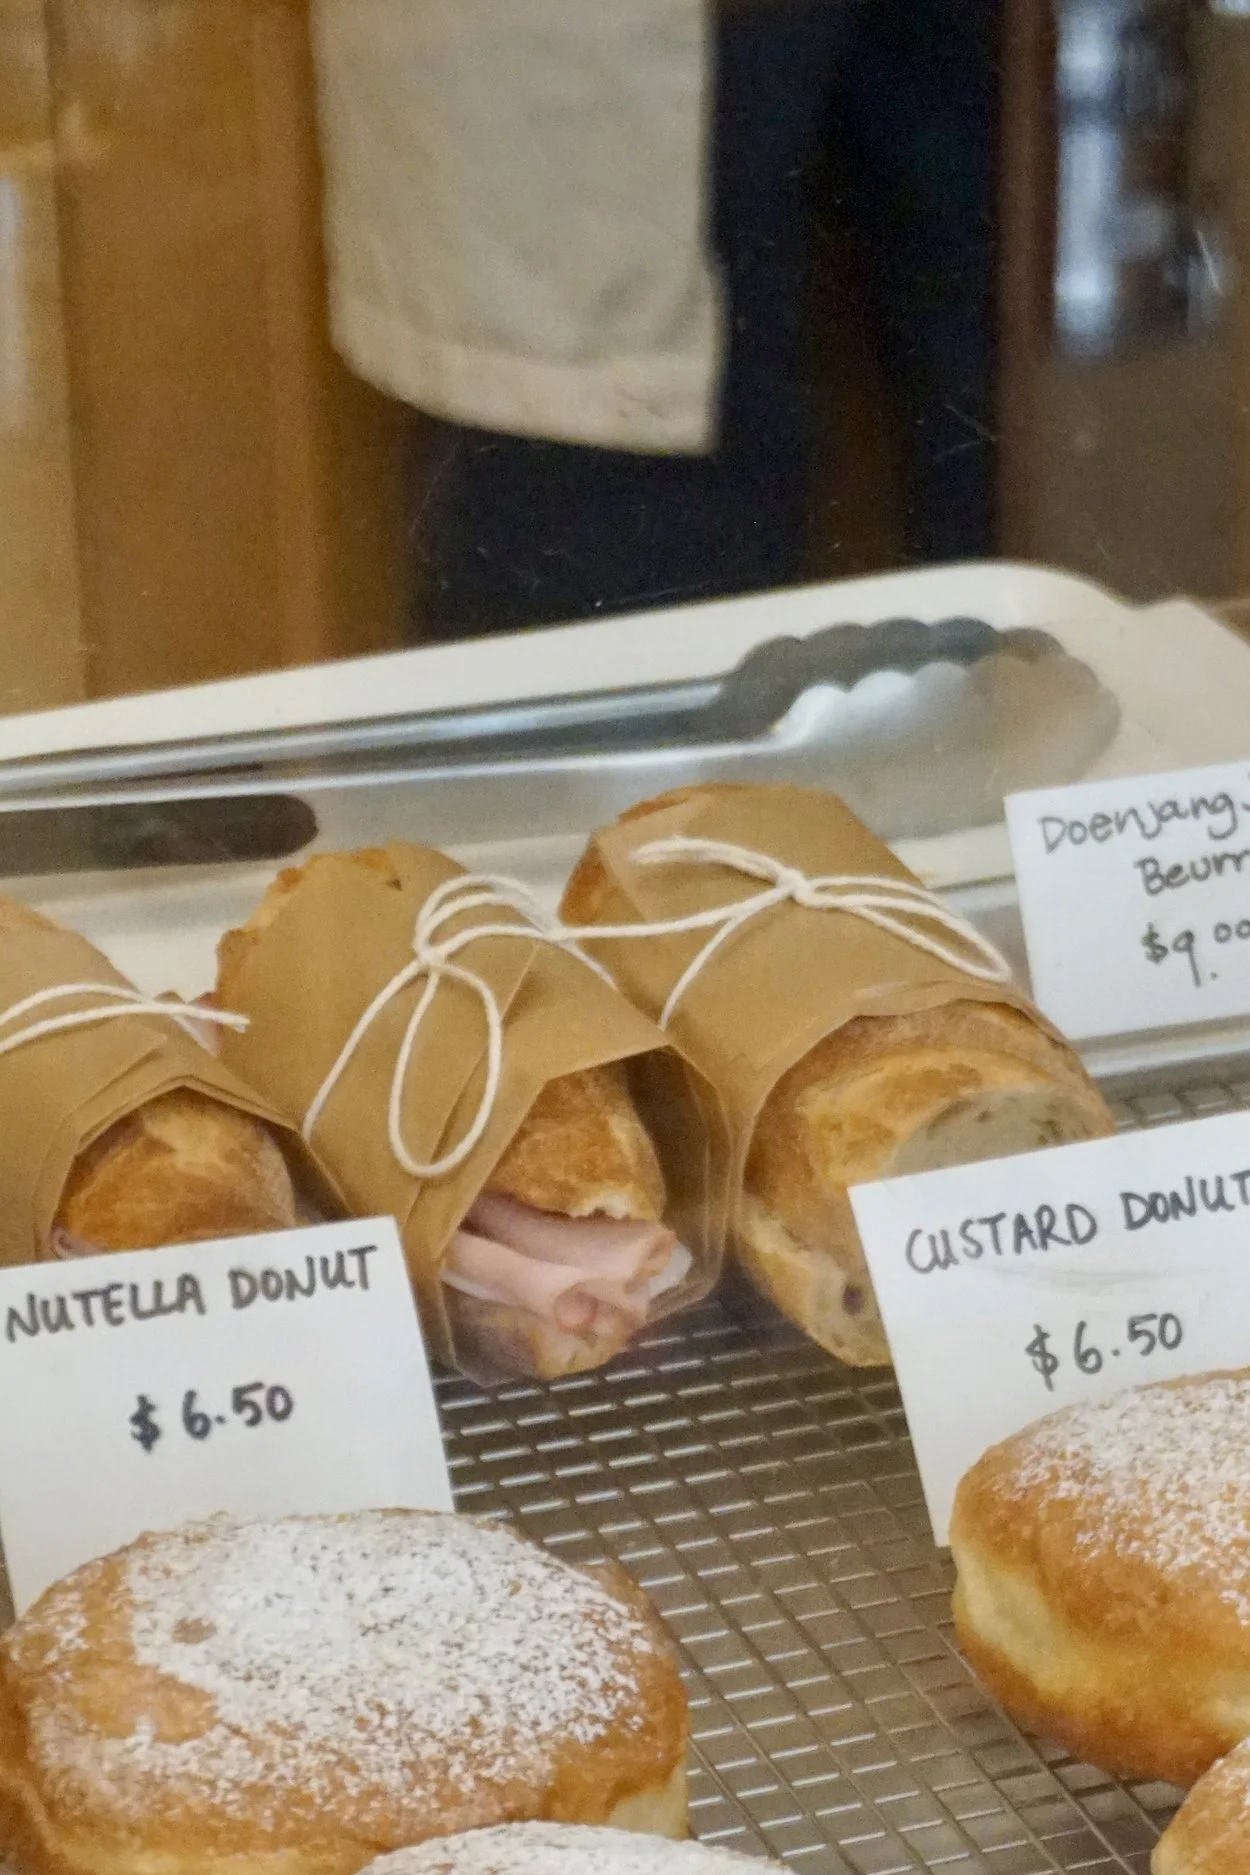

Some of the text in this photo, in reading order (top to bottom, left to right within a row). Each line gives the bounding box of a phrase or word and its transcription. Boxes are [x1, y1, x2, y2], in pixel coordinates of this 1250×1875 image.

[1037, 789, 1238, 854] Doenjang
[905, 1203, 1098, 1274] CUSTARD
[5, 1244, 378, 1343] NUTELLA DONUT
